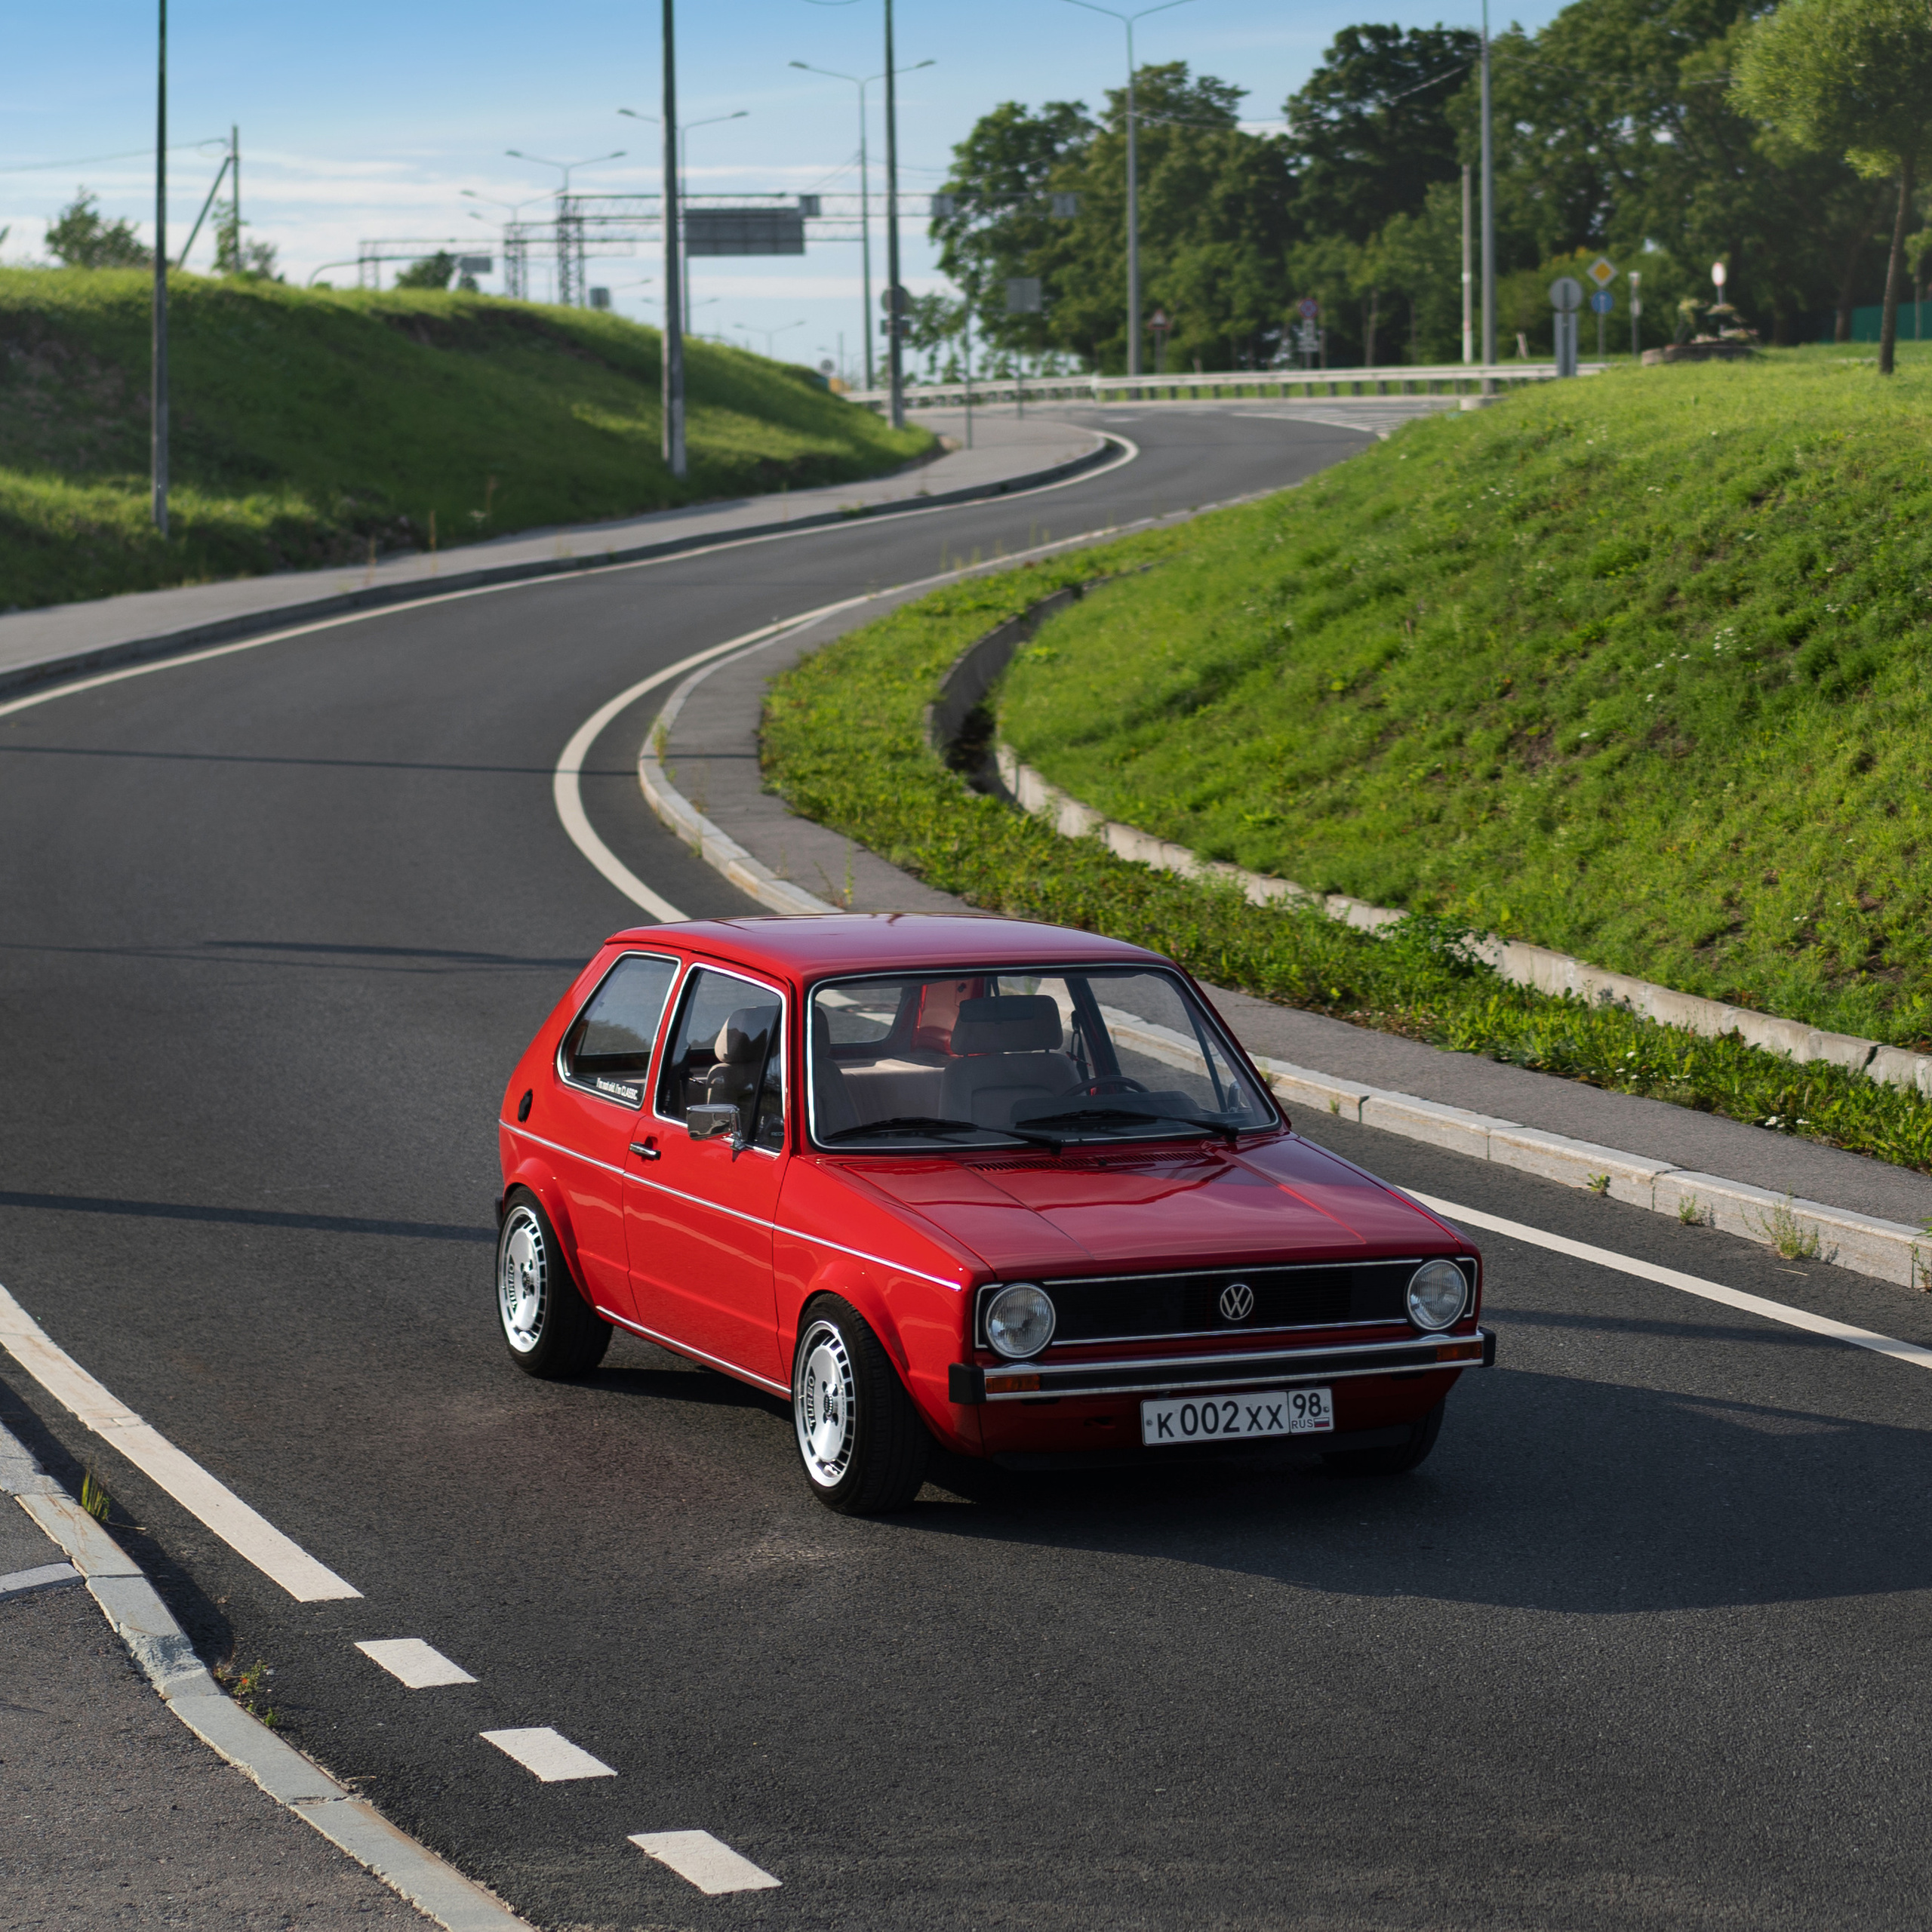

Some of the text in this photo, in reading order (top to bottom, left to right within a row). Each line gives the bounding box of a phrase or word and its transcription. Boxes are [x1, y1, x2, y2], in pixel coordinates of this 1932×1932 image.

[1220, 1284, 1254, 1321] VW
[807, 1375, 816, 1427] TURBO
[1292, 1392, 1322, 1419] 98
[1291, 1418, 1314, 1429] RUS
